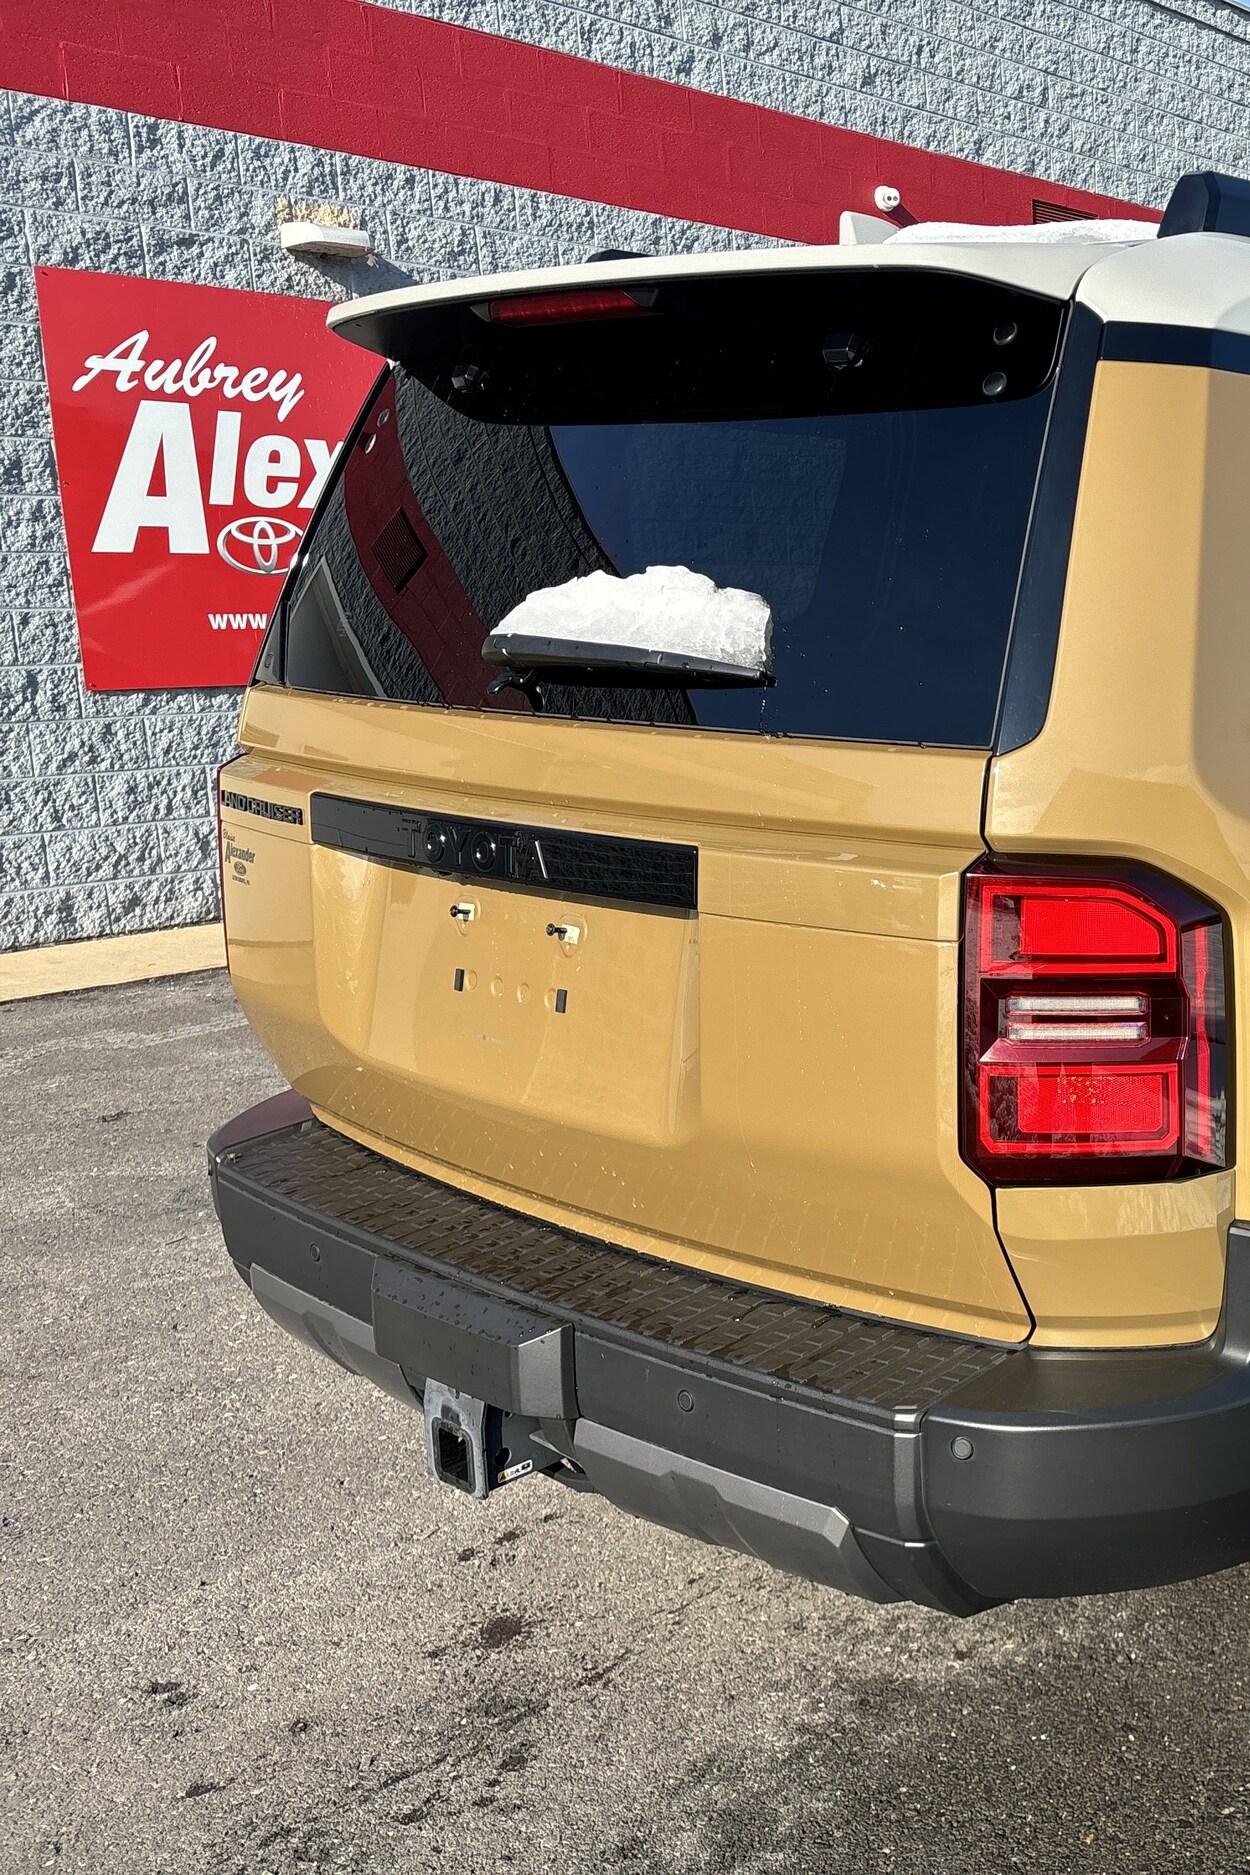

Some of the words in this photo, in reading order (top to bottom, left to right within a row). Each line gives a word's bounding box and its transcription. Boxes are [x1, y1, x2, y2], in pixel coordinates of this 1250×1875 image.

[72, 329, 305, 422] Aubrey
[91, 400, 345, 554] Alex
[402, 817, 549, 880] TOYOTA
